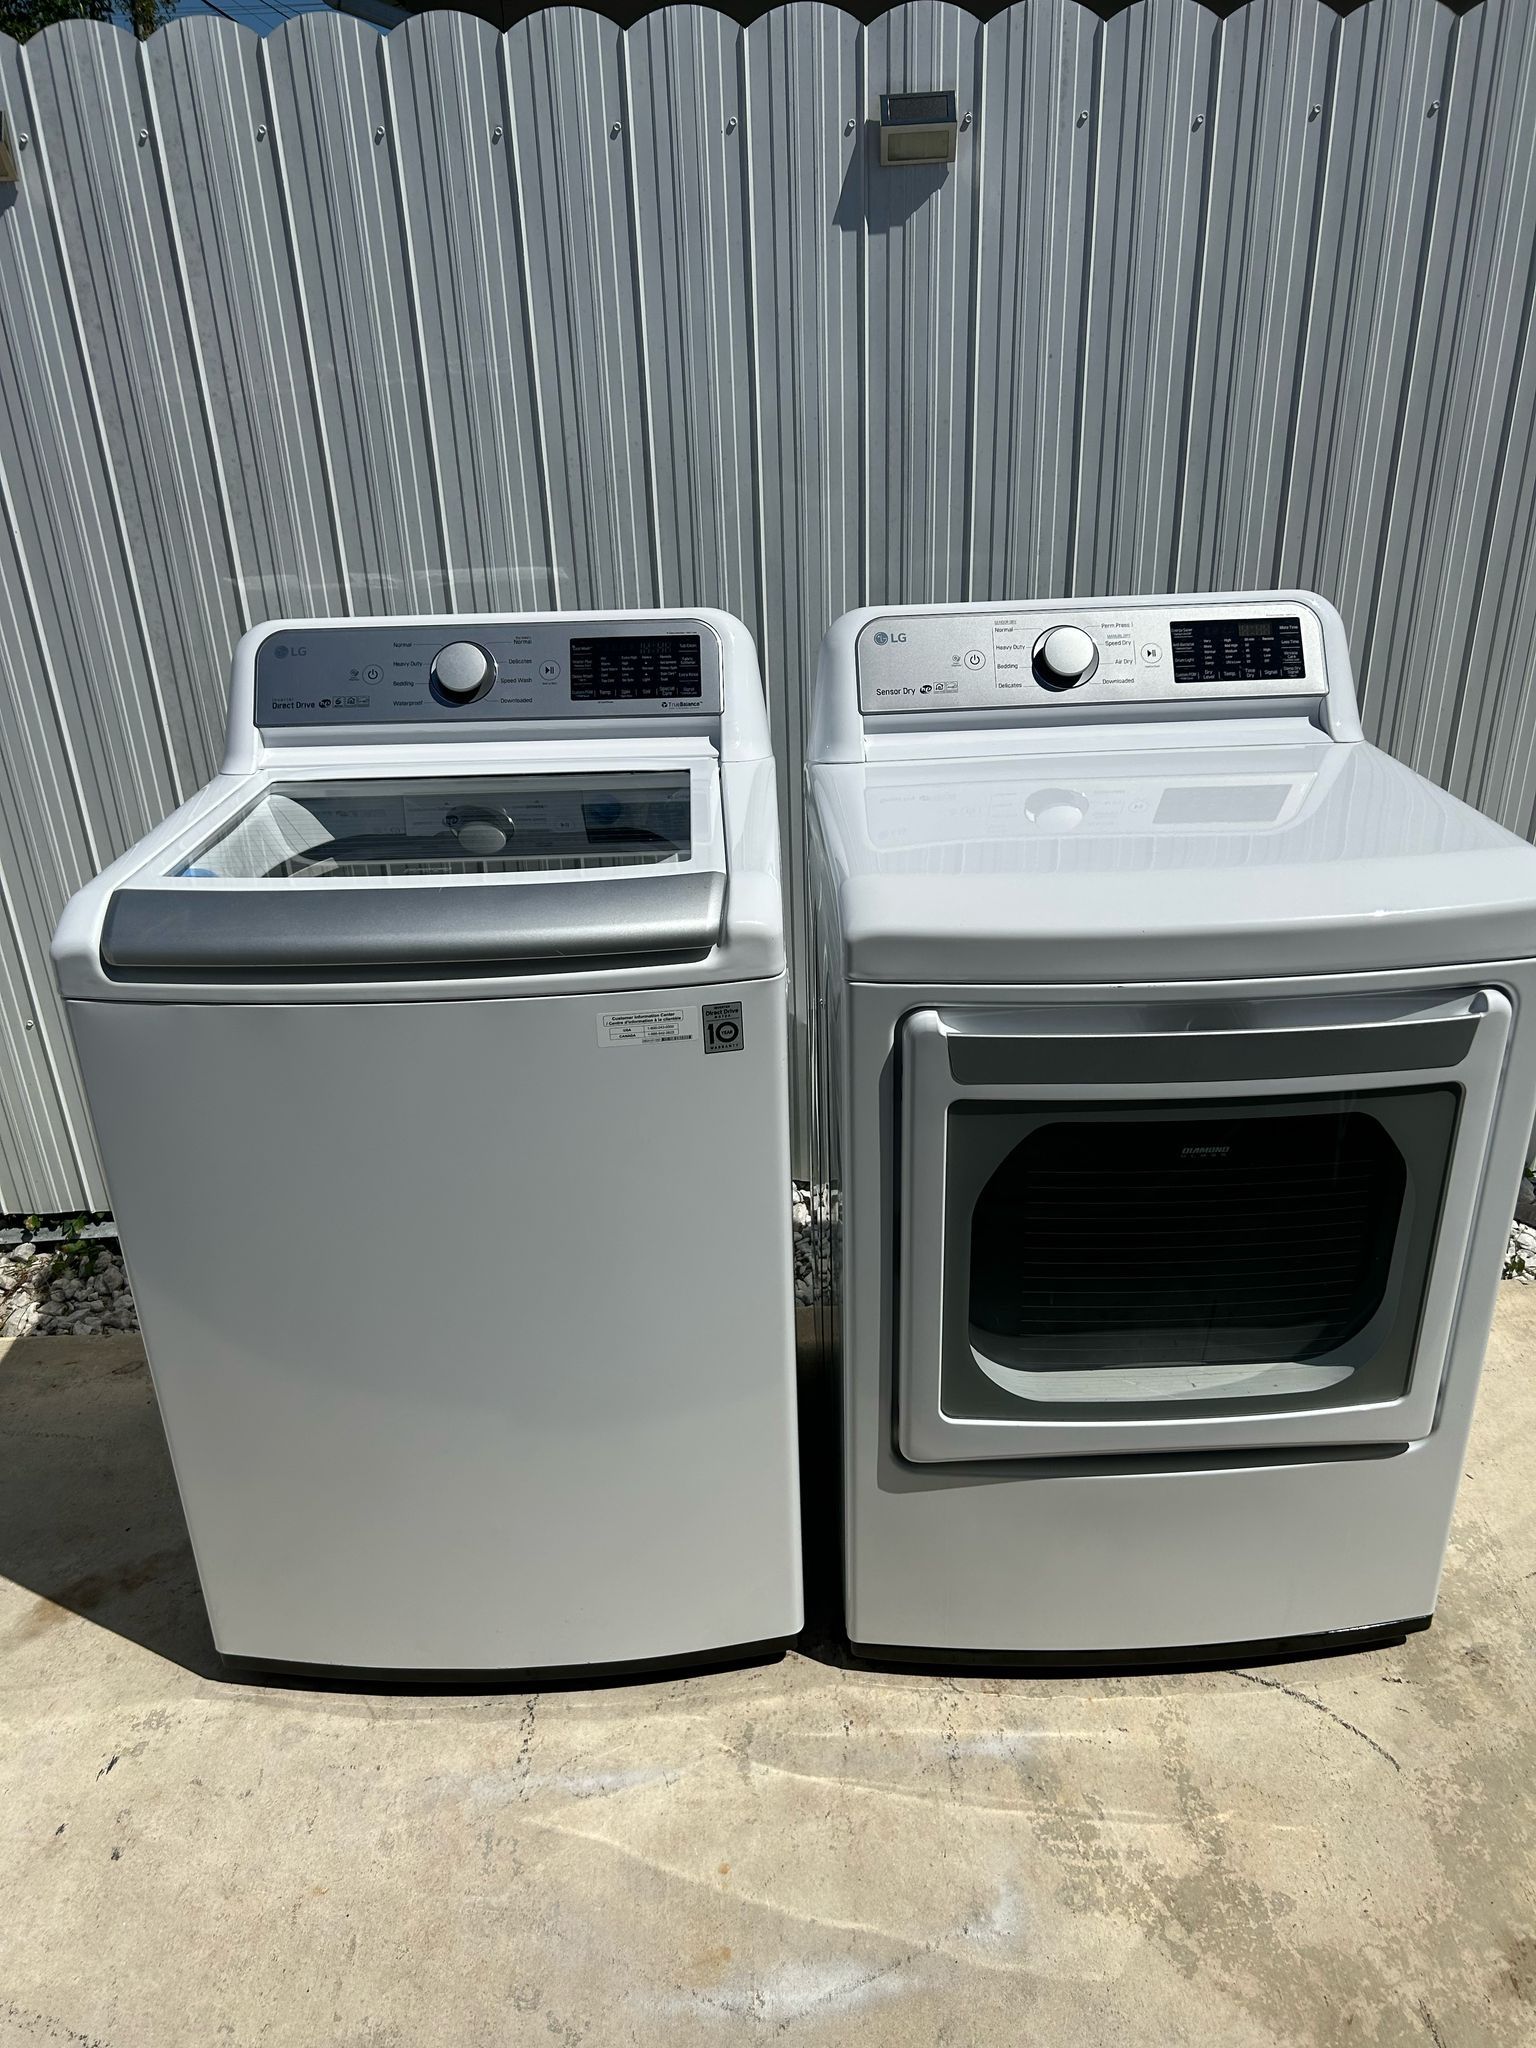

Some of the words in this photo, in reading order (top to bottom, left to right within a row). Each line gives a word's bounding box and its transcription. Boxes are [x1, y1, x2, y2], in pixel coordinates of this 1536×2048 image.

[891, 633, 907, 643] LG
[291, 647, 307, 656] LG
[876, 688, 901, 696] Sensor
[902, 687, 916, 695] Dry
[708, 1022, 739, 1044] 10
[1181, 1146, 1230, 1154] DIAMOND
